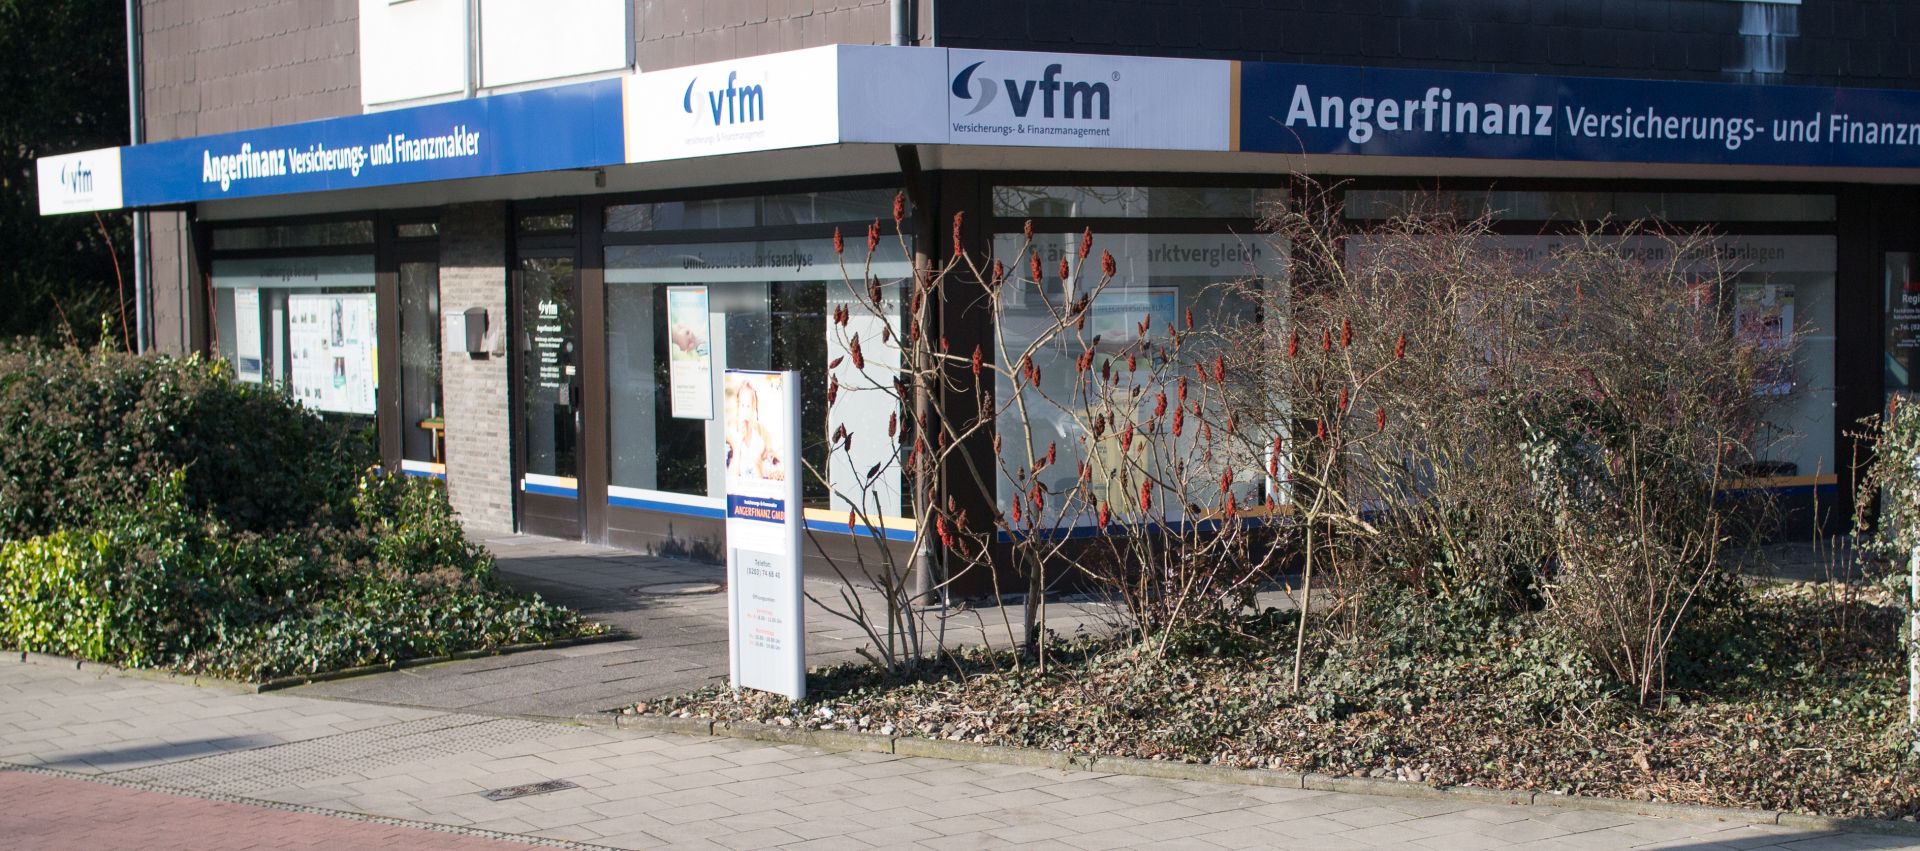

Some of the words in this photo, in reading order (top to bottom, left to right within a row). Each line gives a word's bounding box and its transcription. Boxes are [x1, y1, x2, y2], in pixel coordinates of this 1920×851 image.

[708, 70, 764, 127] vfm
[1004, 63, 1110, 120] vfm
[1285, 84, 1553, 144] Angerfinanz
[1565, 106, 1764, 150] Versicherungs-
[1772, 112, 1821, 143] und
[203, 142, 287, 192] Angerfinanz
[288, 143, 368, 177] Versicherungs-
[370, 134, 393, 167] und
[395, 125, 480, 164] Finanzmakler
[952, 123, 1016, 136] Versicherungs-
[1018, 124, 1025, 134] &
[1027, 125, 1110, 138] Finanzmanagement
[71, 160, 93, 194] vfm
